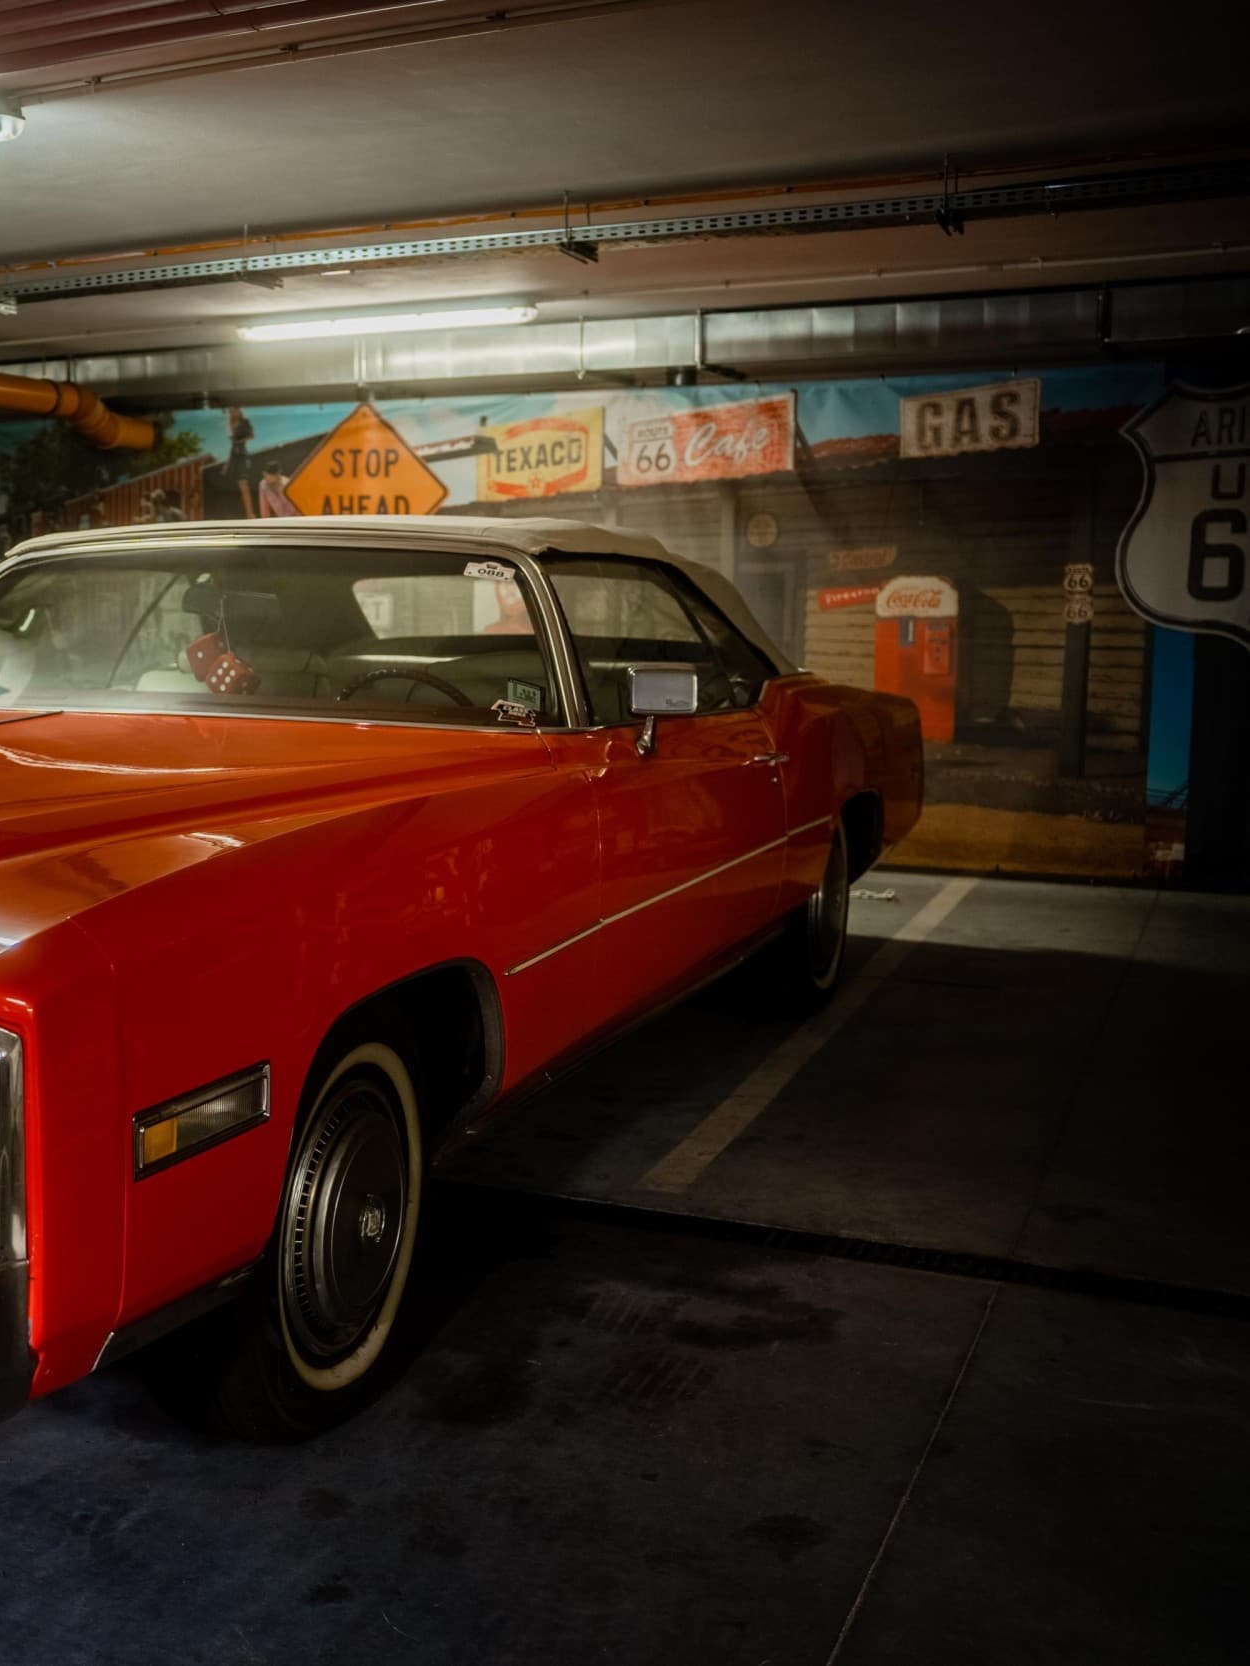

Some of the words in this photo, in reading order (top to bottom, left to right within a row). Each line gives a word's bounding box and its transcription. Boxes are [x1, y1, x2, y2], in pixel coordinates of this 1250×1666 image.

[917, 391, 1021, 449] GAS
[330, 448, 399, 478] STOP
[494, 438, 582, 474] TEXACO
[636, 442, 671, 474] 66
[321, 494, 410, 515] AHEAD
[1068, 575, 1088, 589] 66
